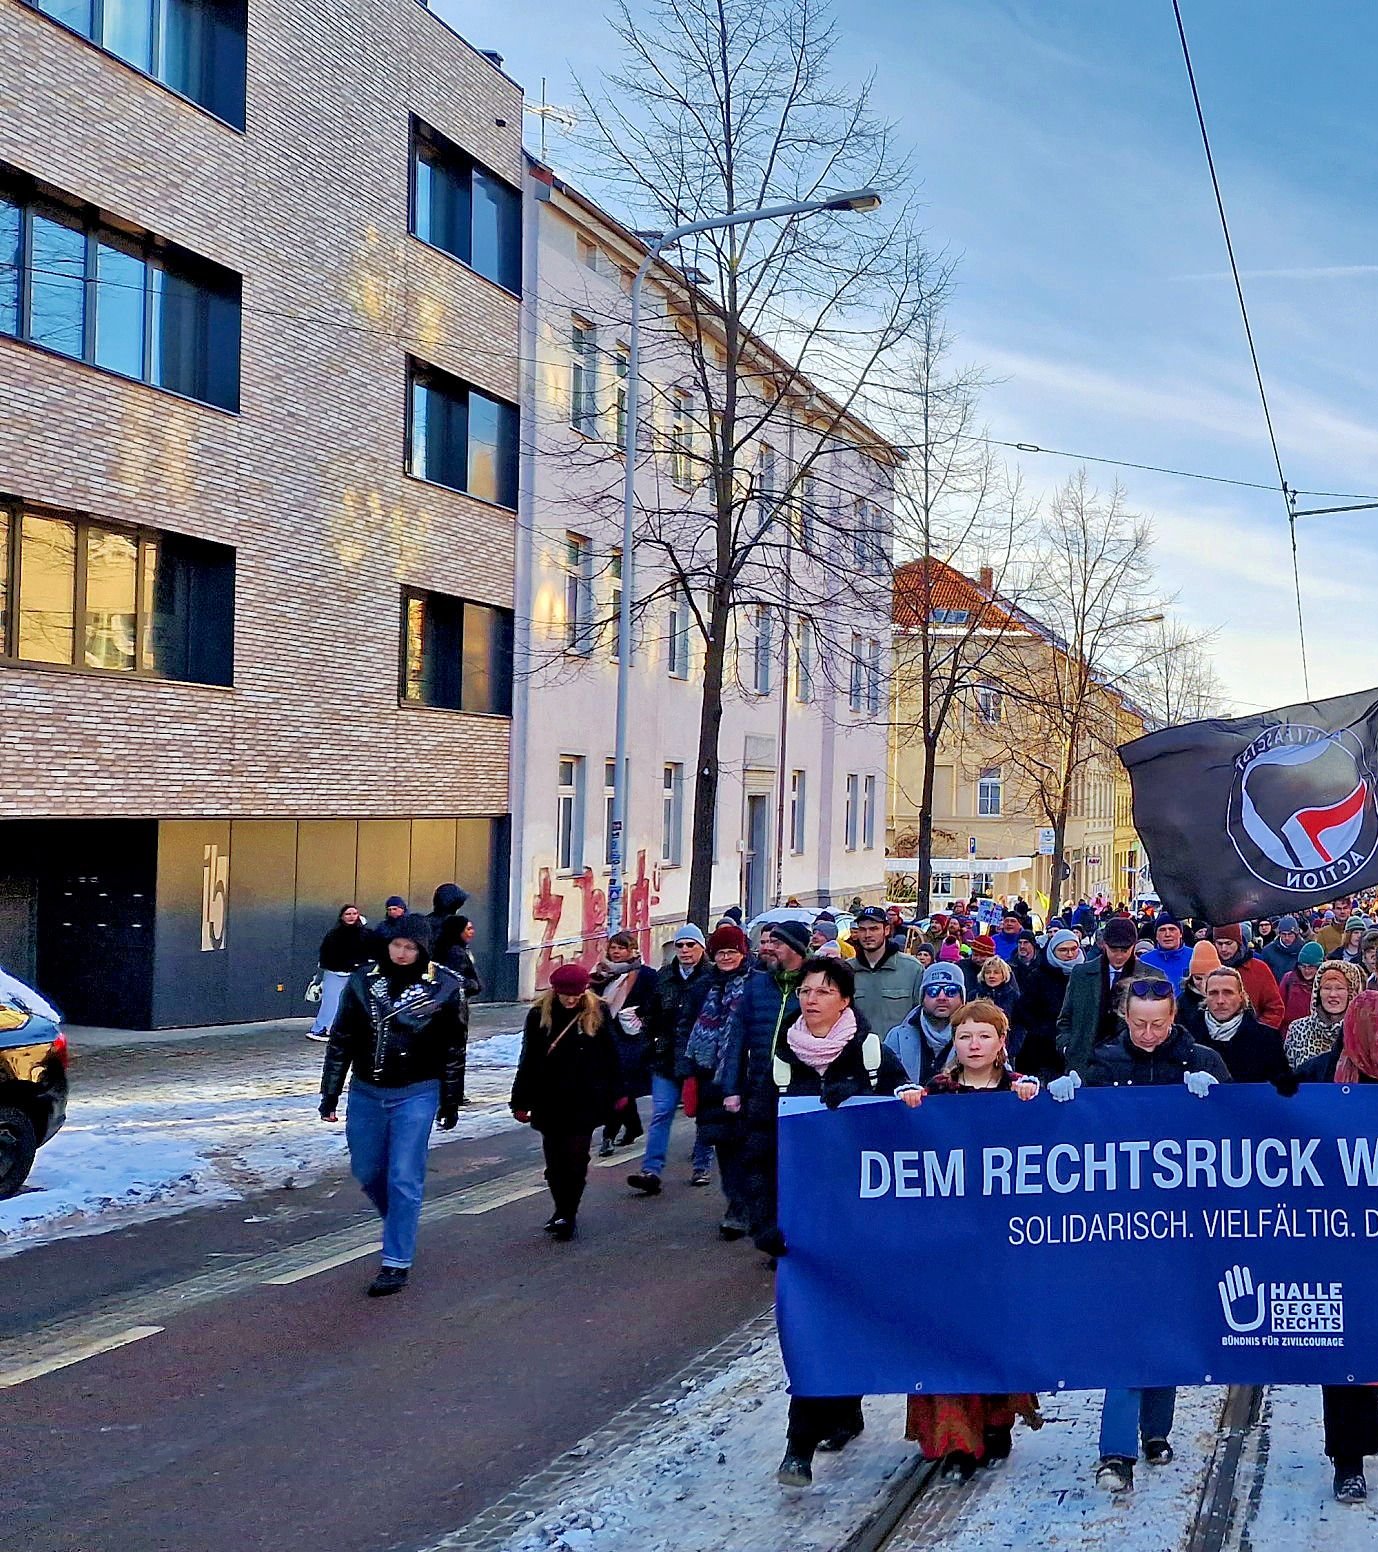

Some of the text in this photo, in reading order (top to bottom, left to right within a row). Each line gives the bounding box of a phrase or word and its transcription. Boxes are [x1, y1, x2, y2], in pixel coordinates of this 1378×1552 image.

[860, 1149, 965, 1199] DEM
[983, 1138, 1323, 1196] RECHTSRUCK
[1008, 1210, 1193, 1246] SOLIDARISCH.
[1203, 1203, 1356, 1239] VIELFÄLTIG.
[1270, 1283, 1343, 1300] HALLE
[1273, 1303, 1341, 1316] GEGEN
[1274, 1317, 1342, 1330] RECHTS
[1222, 1335, 1344, 1347] BÜNDNIS FÜR ZIVILCOURAGE
